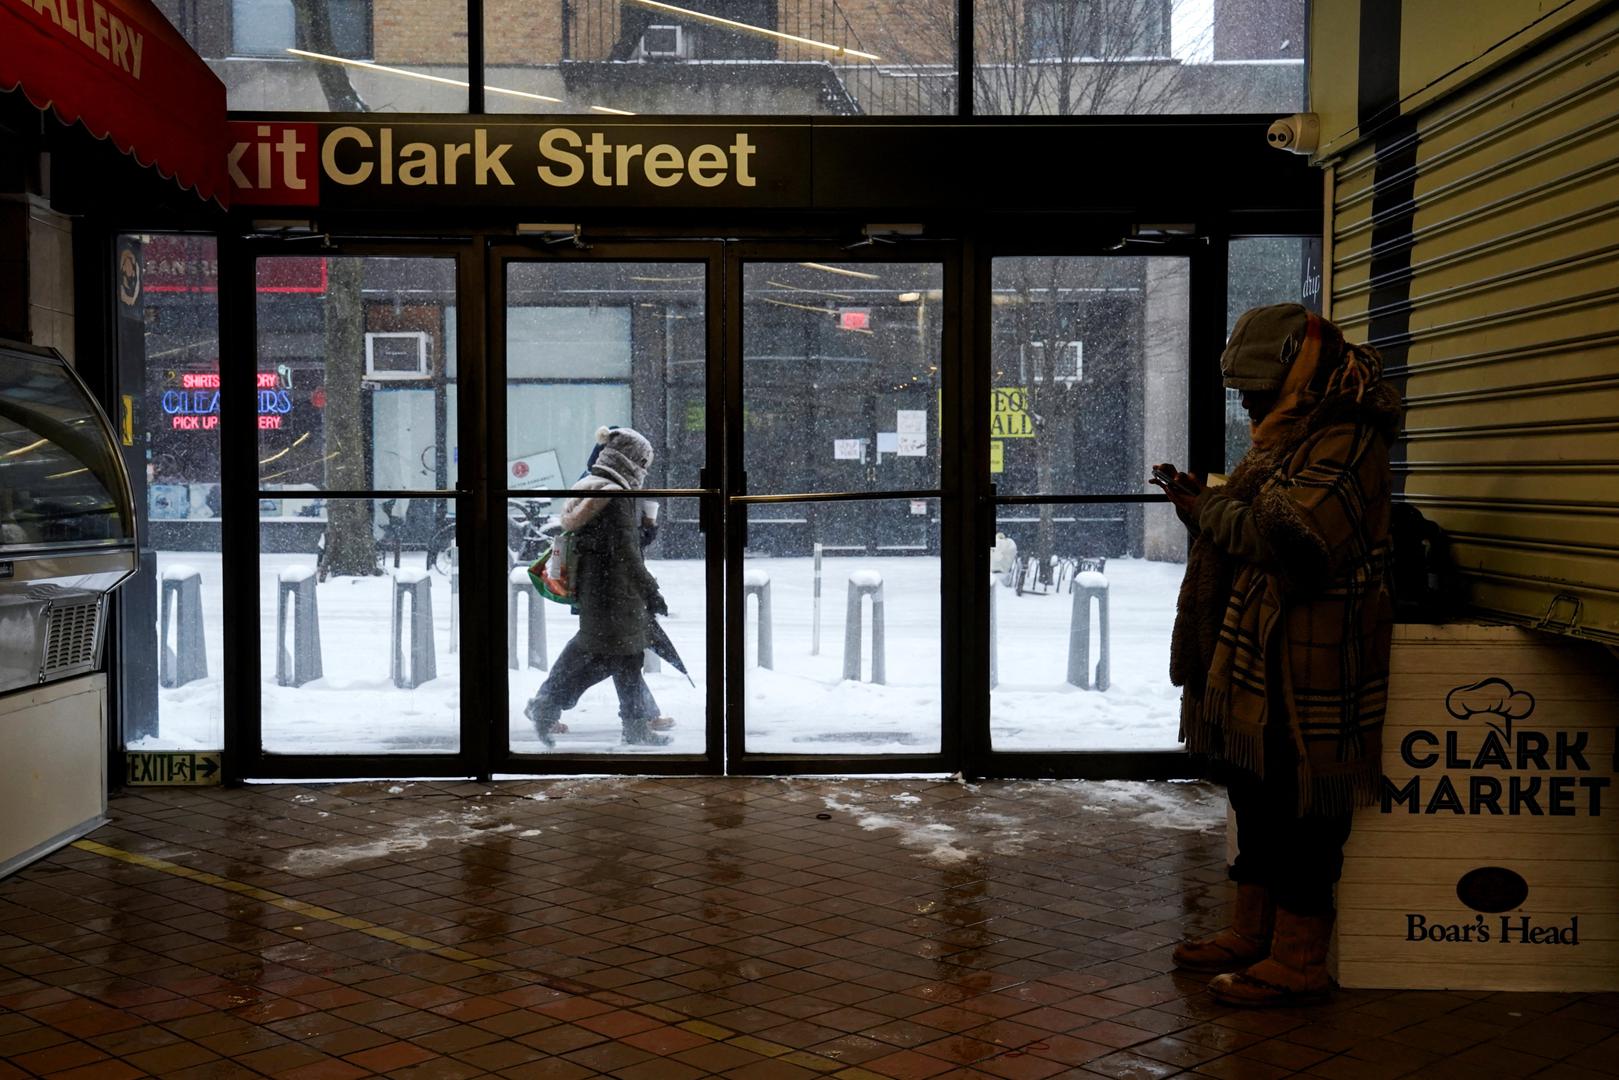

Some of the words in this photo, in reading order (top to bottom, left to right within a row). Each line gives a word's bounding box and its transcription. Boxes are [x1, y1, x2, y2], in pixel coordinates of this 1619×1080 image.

[22, 0, 144, 80] ALLERY
[321, 126, 515, 186] Clark
[537, 127, 756, 187] Street
[183, 373, 220, 388] SHIRTS
[173, 415, 199, 430] PICK
[202, 415, 218, 430] UP
[130, 753, 168, 782] EXIT
[1401, 730, 1590, 770] CLARK
[1381, 775, 1611, 816] MARKET
[1405, 914, 1490, 943] Boar's
[1499, 916, 1580, 946] Head
